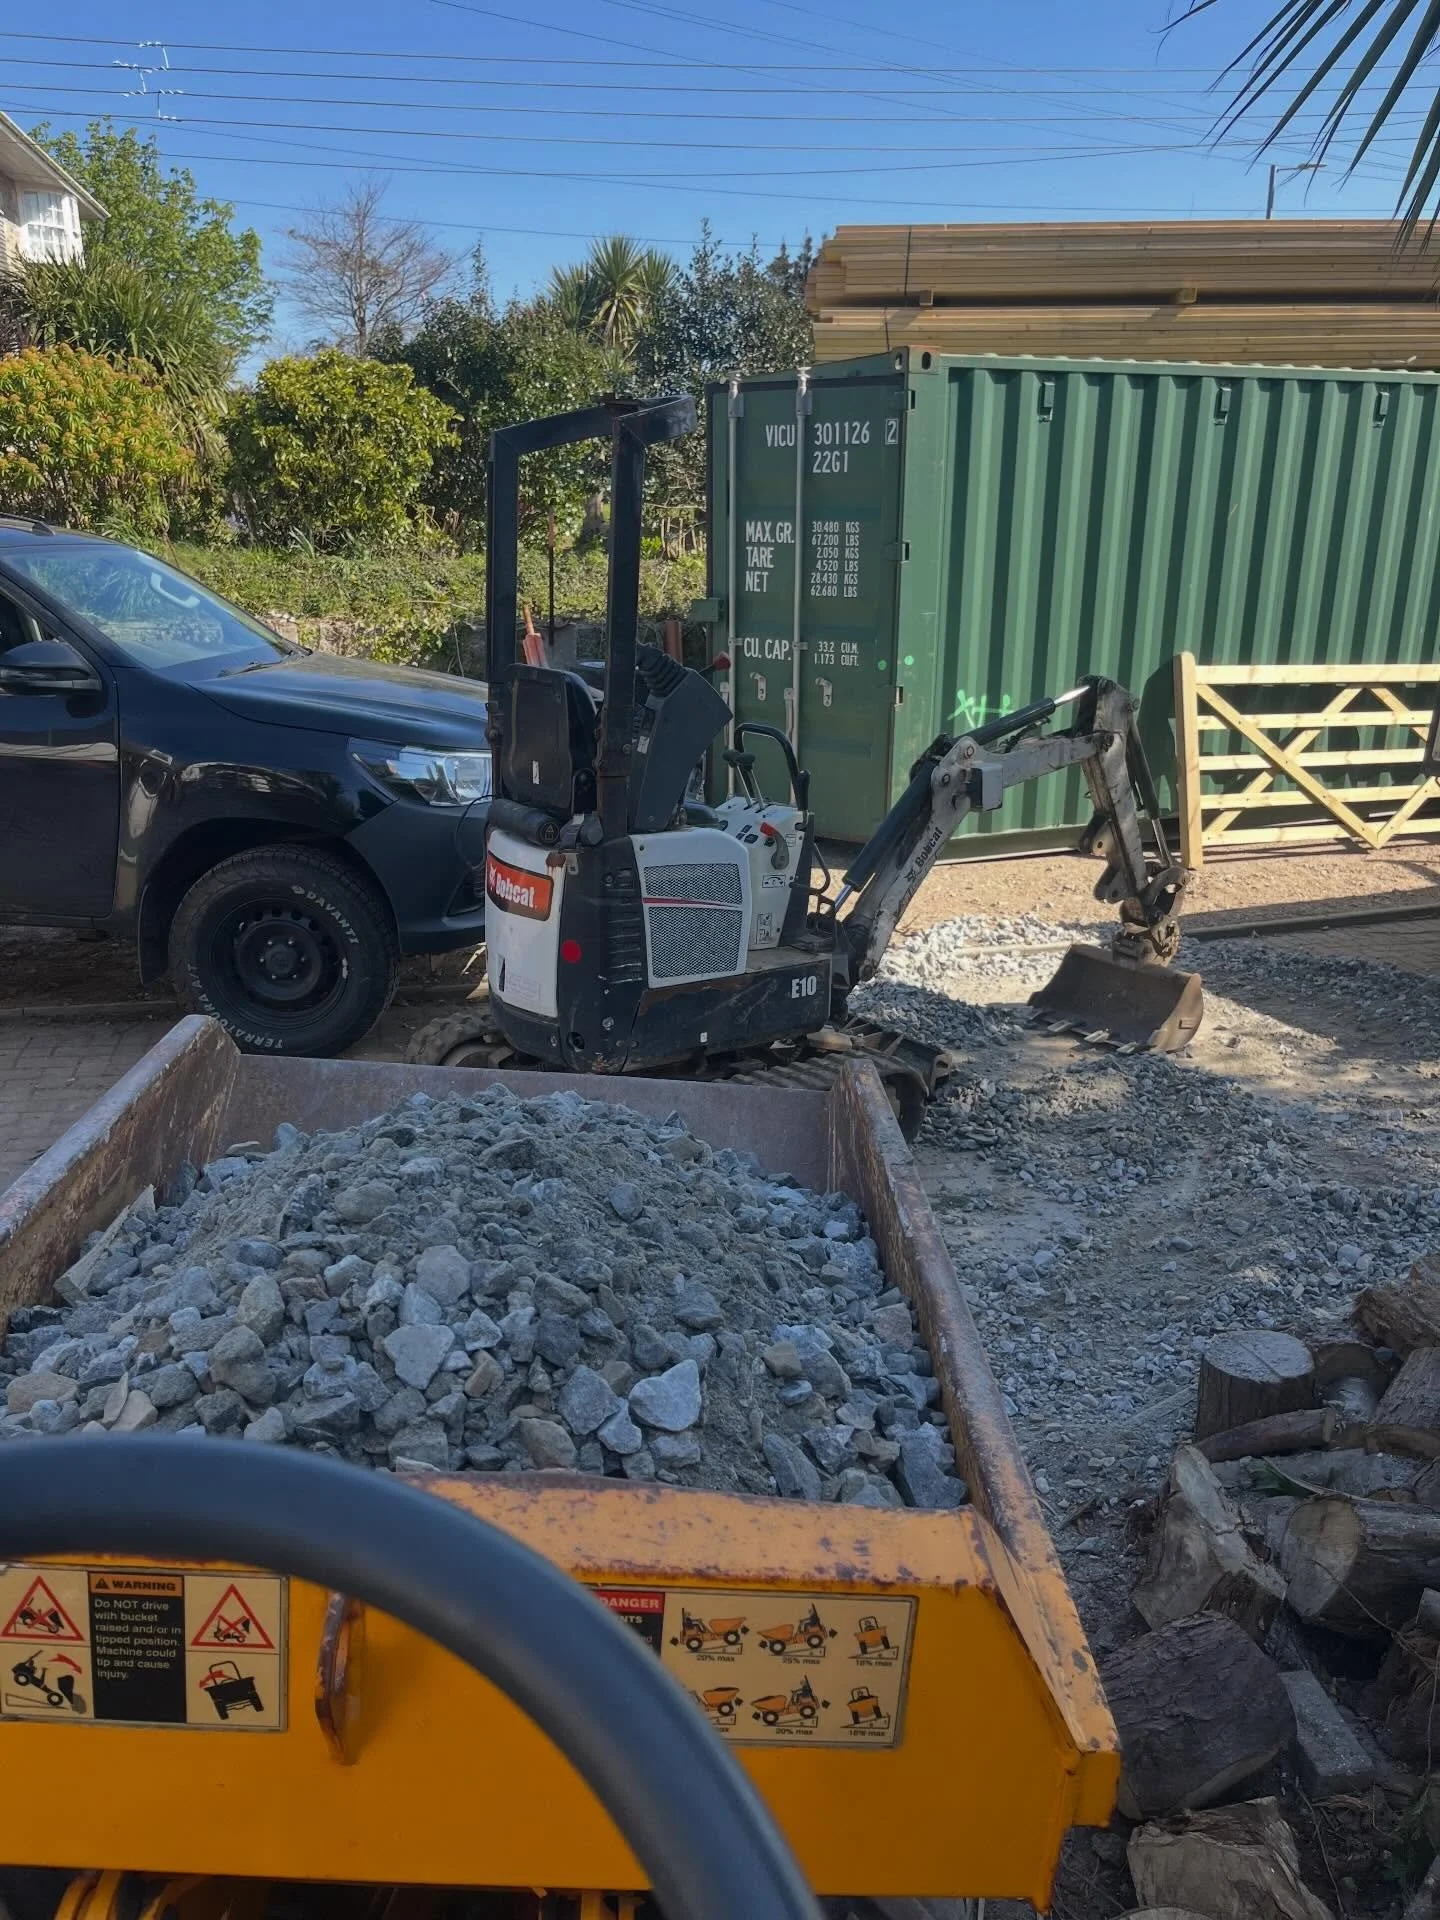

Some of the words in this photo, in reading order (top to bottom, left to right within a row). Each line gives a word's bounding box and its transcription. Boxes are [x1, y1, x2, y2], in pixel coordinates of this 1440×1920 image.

[765, 424, 796, 447] VICU
[814, 421, 870, 446] 301126
[886, 420, 898, 444] 2
[812, 451, 849, 473] 22G1
[812, 521, 839, 533] 30.480
[845, 521, 860, 533] KGS
[812, 534, 839, 546] 67.200
[845, 534, 859, 546] LBS
[745, 546, 774, 569] TARE
[816, 547, 839, 559] 2.050
[845, 547, 859, 559] KGS
[816, 560, 839, 571] 4.520
[844, 560, 859, 572] LBS
[745, 571, 769, 593] NET
[811, 572, 838, 584] 28.430
[844, 573, 858, 585] KGS
[810, 585, 838, 597] 62.680
[843, 585, 857, 598] LBS
[743, 637, 762, 658] CU.
[765, 638, 792, 660] CAP.
[818, 641, 835, 653] 33.2
[914, 826, 943, 868] Bobcat
[496, 873, 535, 908] Bobcat
[306, 890, 360, 943] DAVANTI
[791, 975, 817, 999] E10
[112, 1579, 176, 1592] WARNING
[94, 1599, 111, 1609] Do
[113, 1599, 138, 1609] NOT
[141, 1600, 169, 1611] drive
[95, 1611, 117, 1620] with
[120, 1612, 158, 1622] bucket
[95, 1623, 129, 1632] raised
[132, 1624, 168, 1634] and/or
[171, 1626, 181, 1635] in
[95, 1634, 131, 1645] tipped
[133, 1636, 181, 1647] position.
[96, 1646, 142, 1656] Machine
[145, 1648, 176, 1658] could
[96, 1657, 111, 1668] tip
[113, 1659, 134, 1668] and
[136, 1660, 170, 1669] cause
[97, 1669, 129, 1680] injury.
